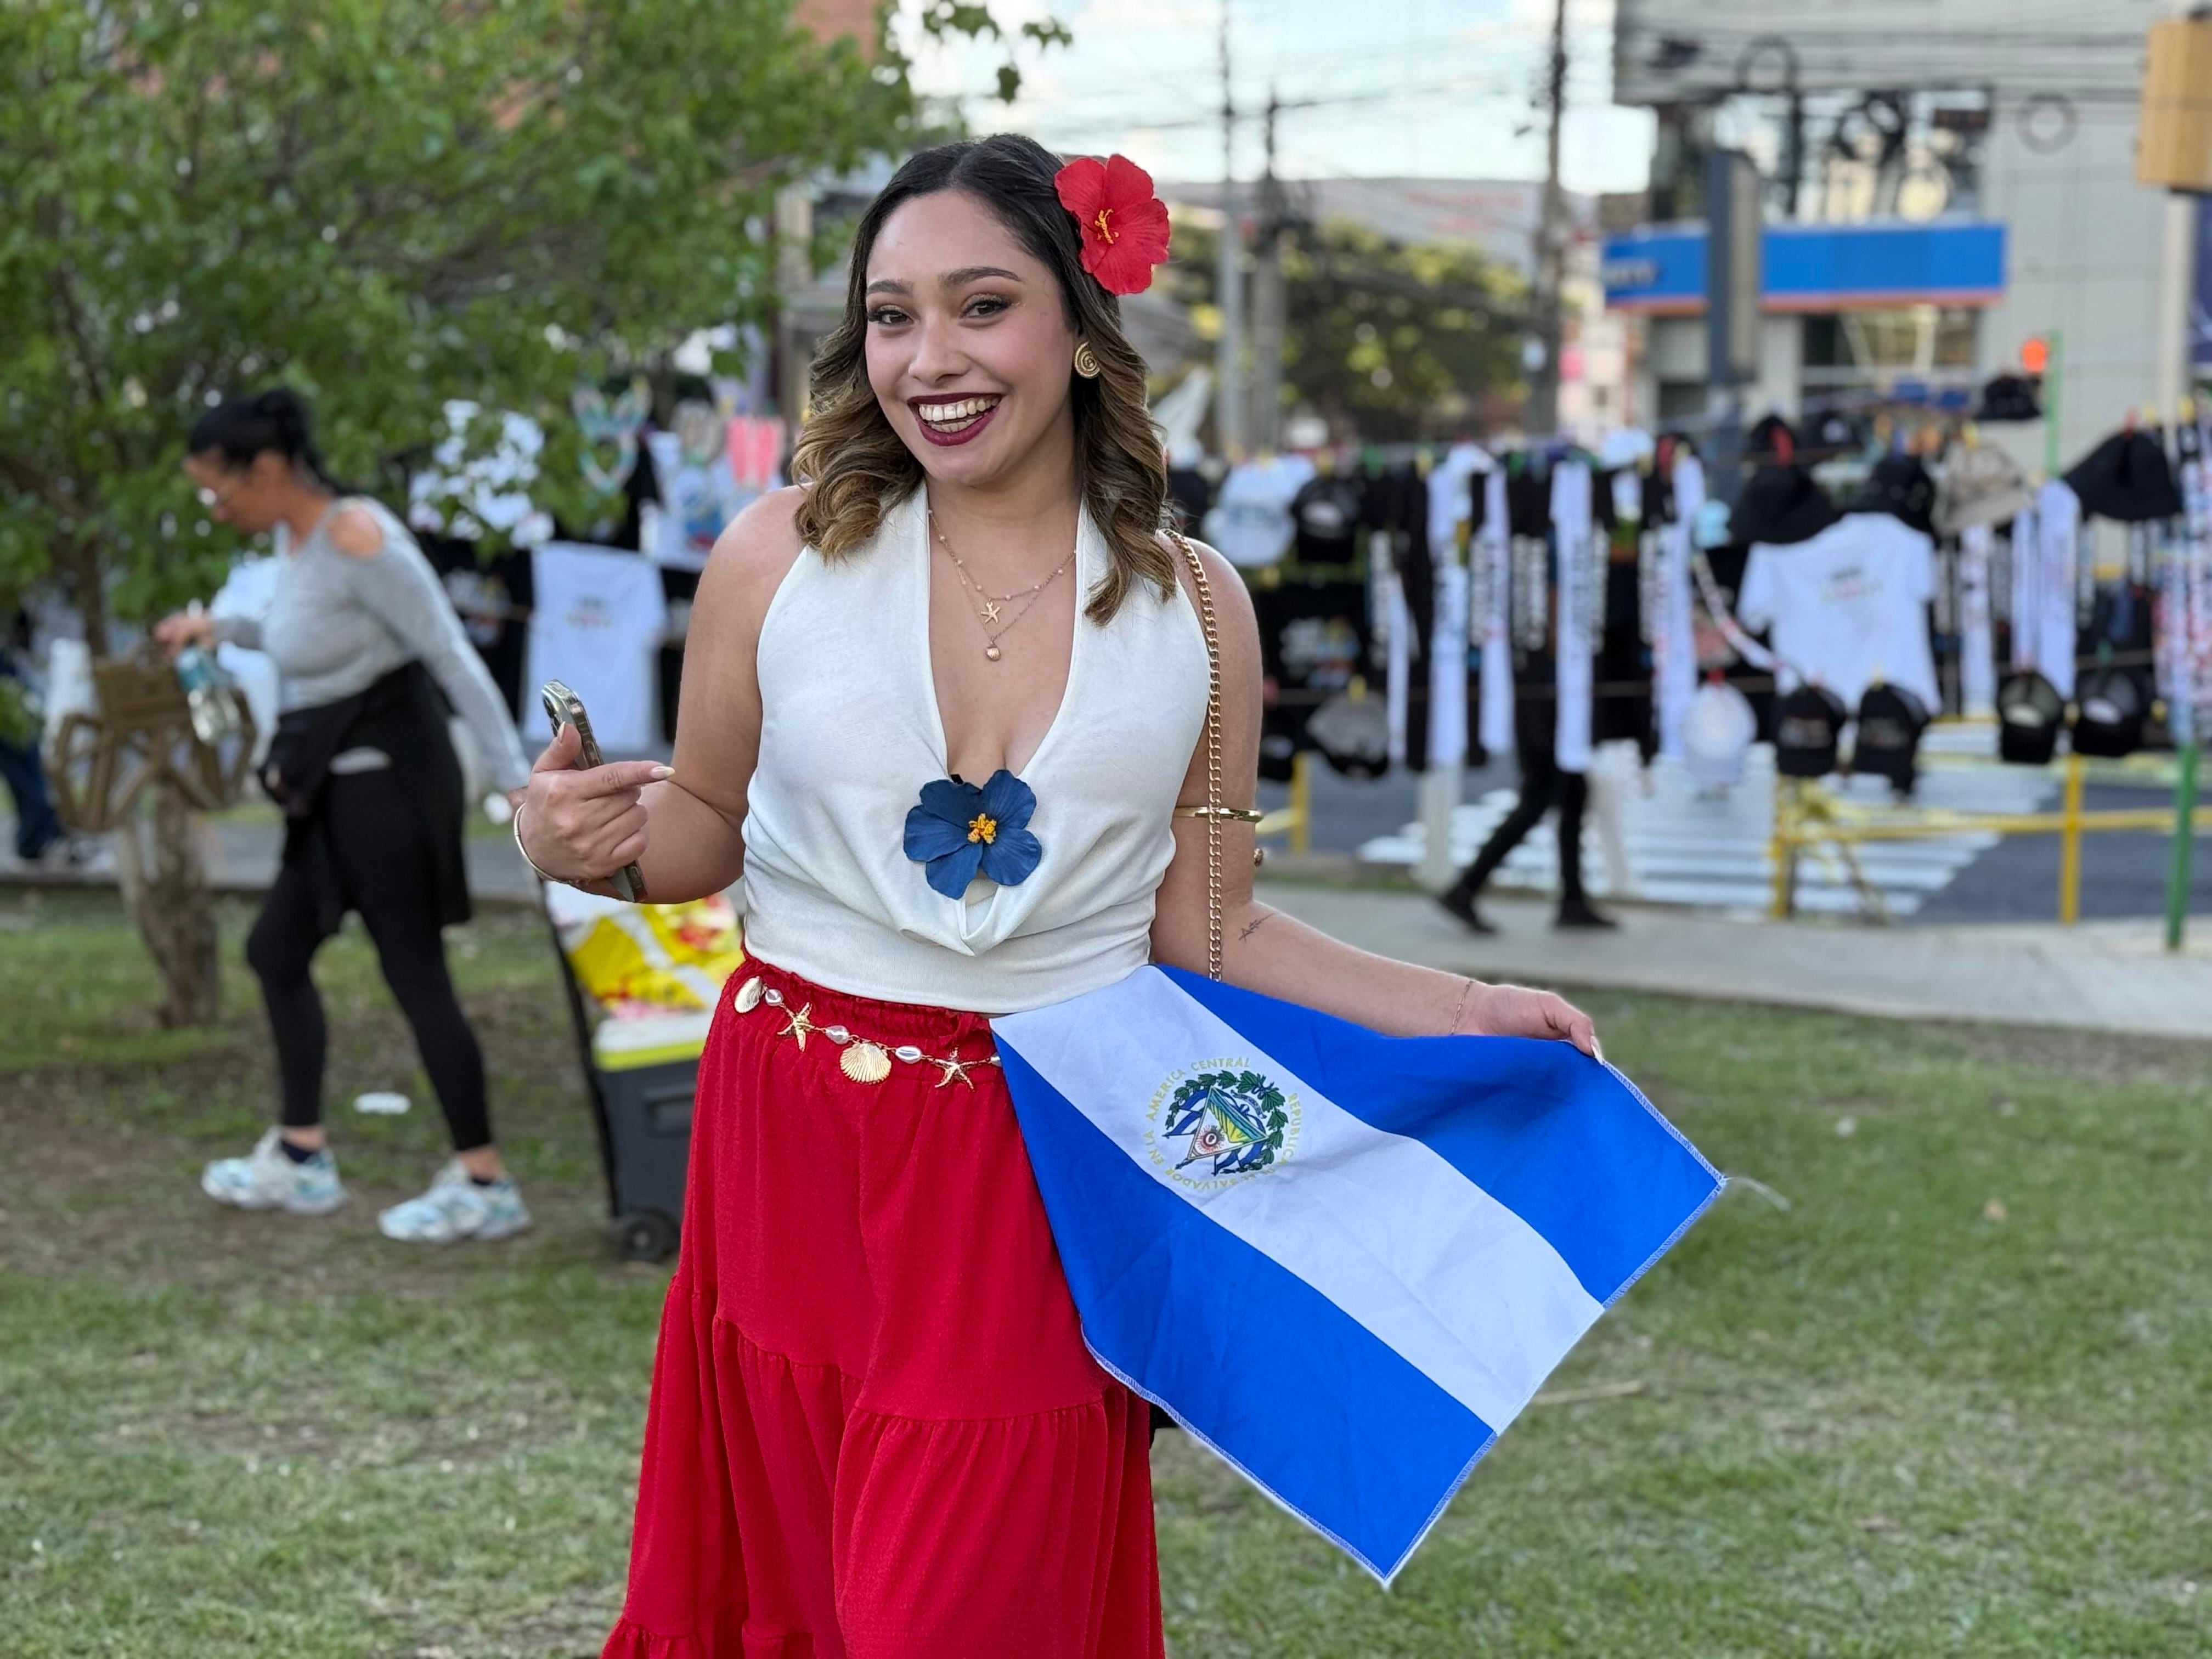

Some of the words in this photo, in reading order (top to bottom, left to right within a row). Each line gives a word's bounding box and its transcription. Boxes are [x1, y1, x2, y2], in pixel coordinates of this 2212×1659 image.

[1190, 1057, 1251, 1071] CENTRAL
[1146, 1068, 1186, 1121] AMERICA
[1165, 1167, 1237, 1189] SALVADOR
